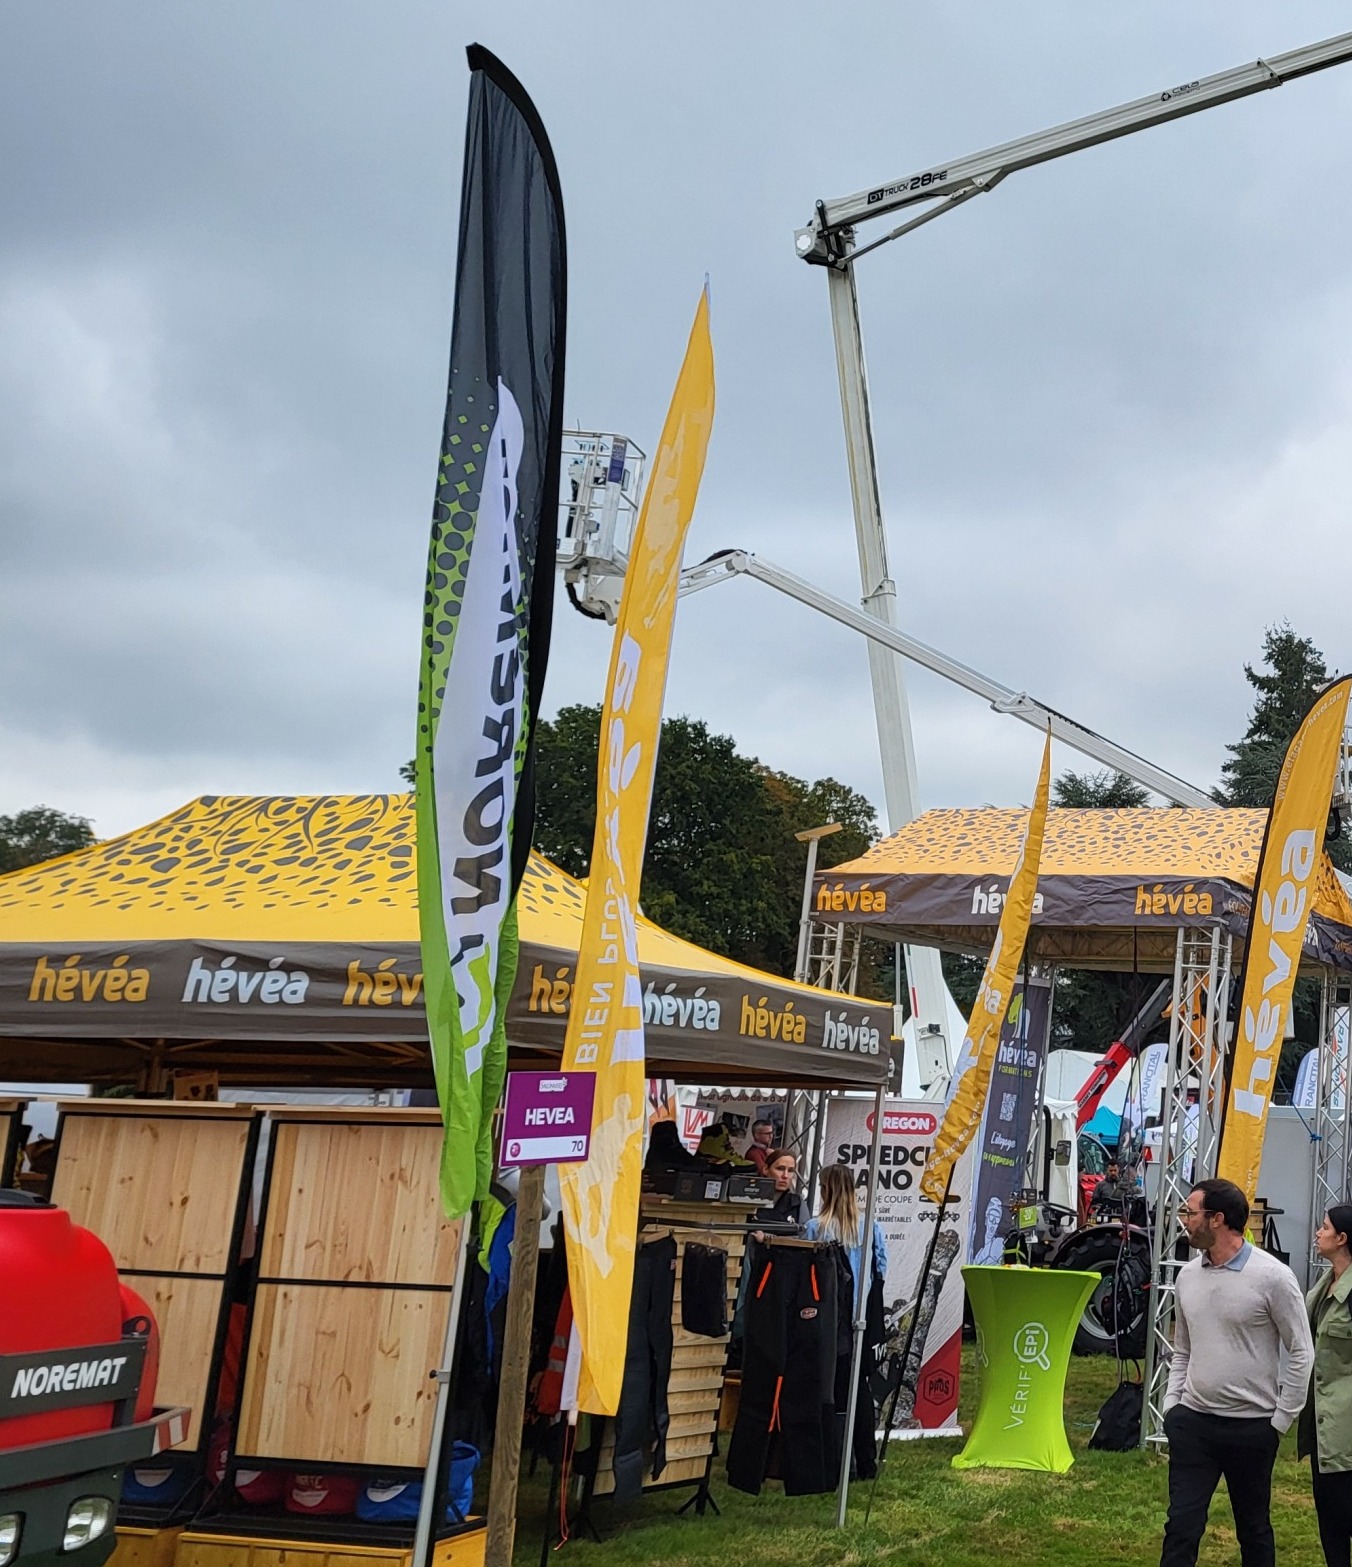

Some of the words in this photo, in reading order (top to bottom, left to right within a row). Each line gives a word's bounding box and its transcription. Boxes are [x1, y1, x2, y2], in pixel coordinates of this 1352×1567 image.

[885, 183, 909, 197] TRUCK
[817, 881, 888, 913] hévéa
[1134, 884, 1213, 916] hévéa
[28, 955, 151, 1002] hévéa
[181, 956, 311, 1003] hévéa
[1234, 826, 1317, 1121] hévéa
[642, 980, 722, 1032] hévéa
[740, 994, 807, 1044] hévéa
[821, 1009, 881, 1056] hévéa
[524, 1106, 575, 1126] HEVEA
[873, 1116, 931, 1131] REGON
[571, 1140, 584, 1153] 70
[884, 1195, 913, 1204] COUPE
[11, 1357, 127, 1398] NOREMAT
